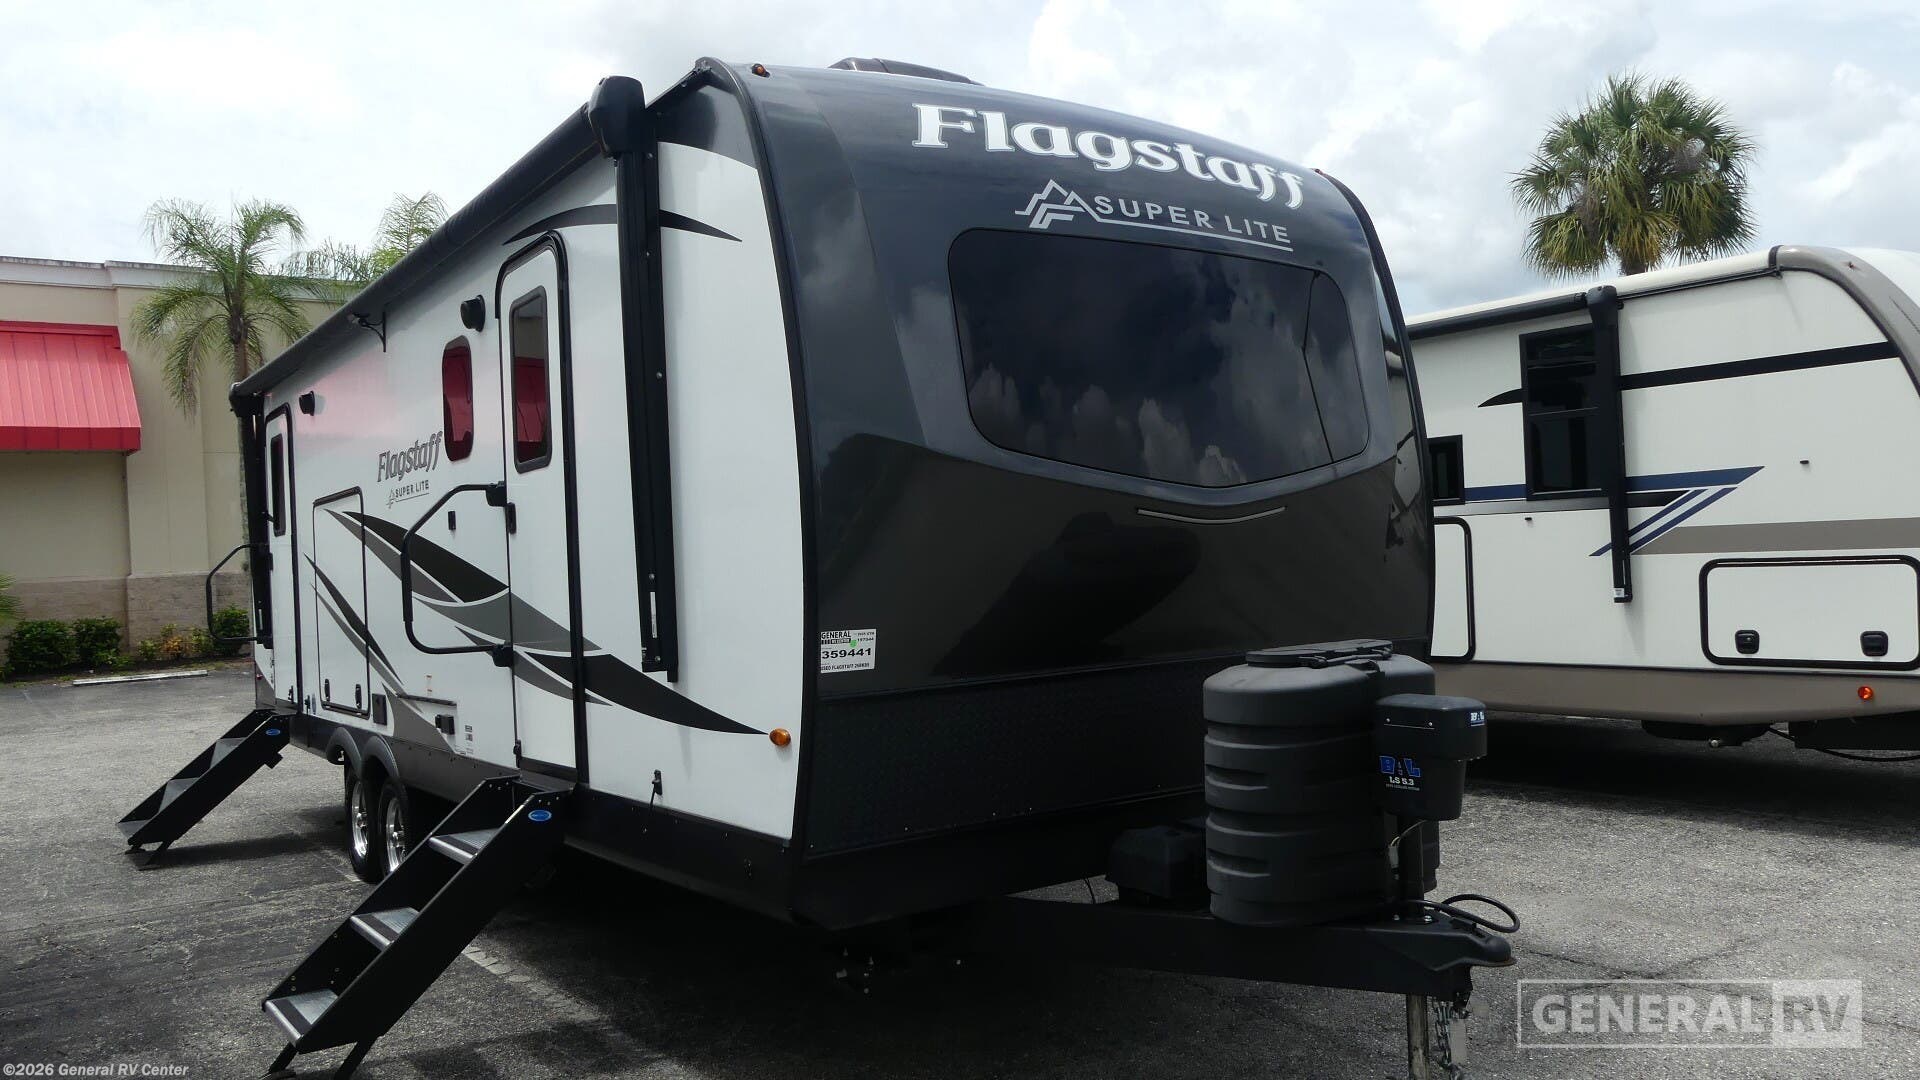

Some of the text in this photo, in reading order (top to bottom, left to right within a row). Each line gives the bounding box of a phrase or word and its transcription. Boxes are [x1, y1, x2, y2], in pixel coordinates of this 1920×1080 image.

[911, 102, 1304, 209] Flagstaff
[1095, 195, 1292, 244] SUPER LITE
[377, 430, 443, 482] Flagstaff
[395, 479, 430, 498] SUPER LITE
[821, 631, 852, 640] GENERAL
[821, 647, 871, 659] 359441
[1389, 775, 1401, 785] LS
